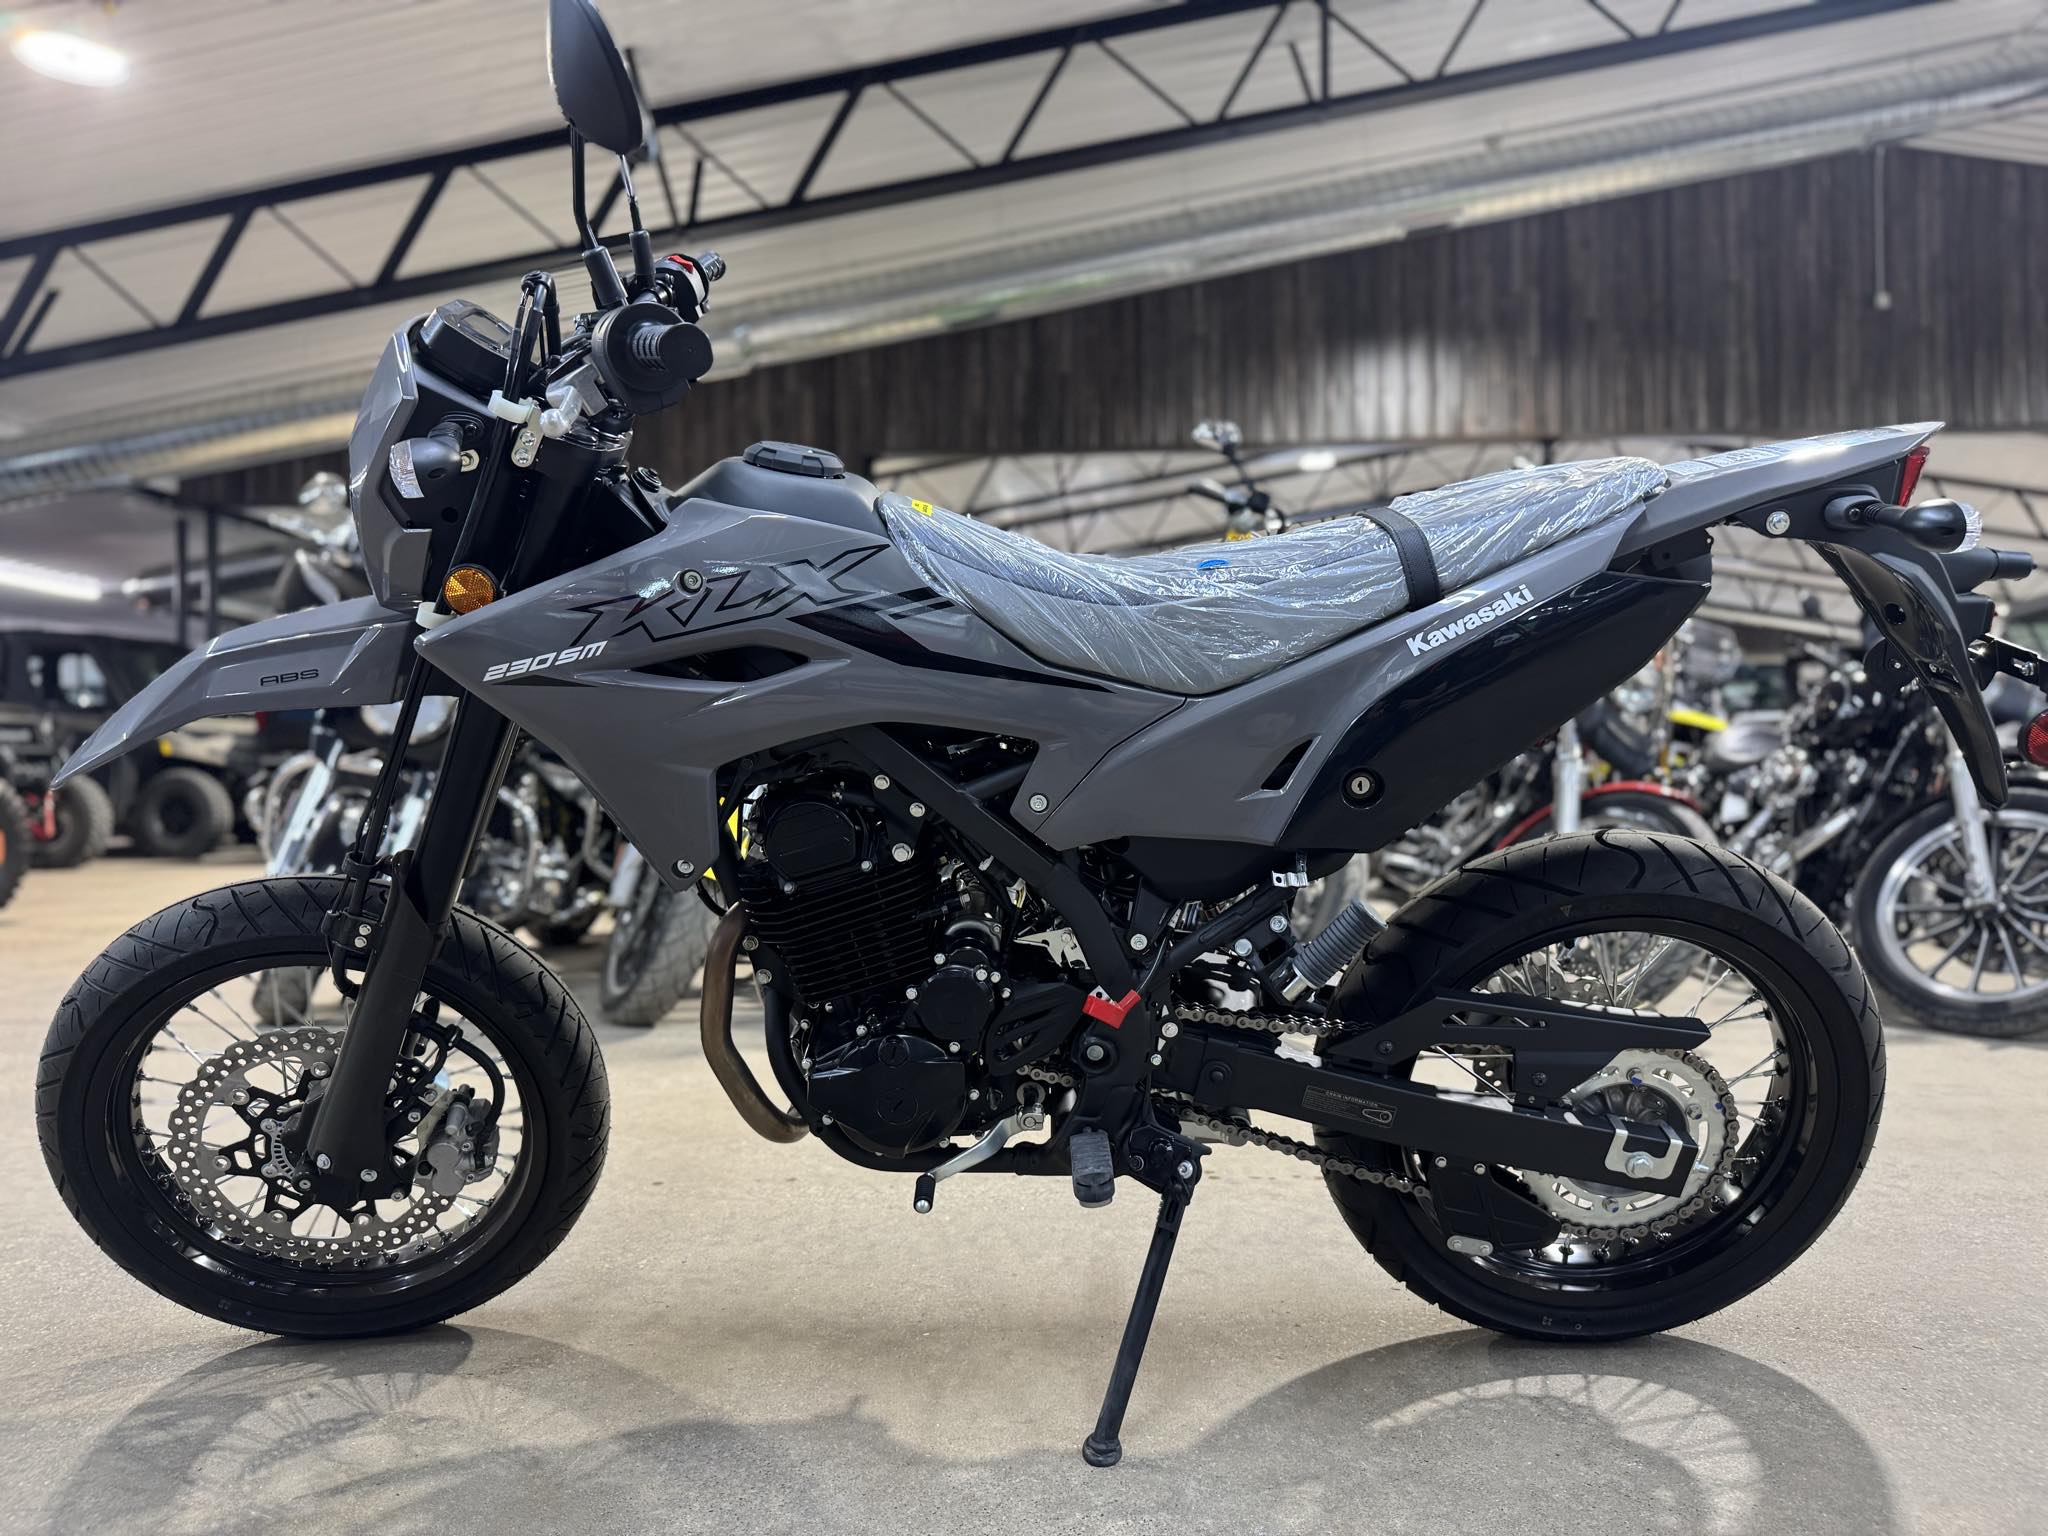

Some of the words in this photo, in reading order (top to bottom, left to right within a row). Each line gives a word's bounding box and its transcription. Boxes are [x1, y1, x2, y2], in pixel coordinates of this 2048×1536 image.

[567, 544, 890, 647] KLX
[1406, 584, 1534, 656] Kawasaki
[260, 668, 319, 686] ABS
